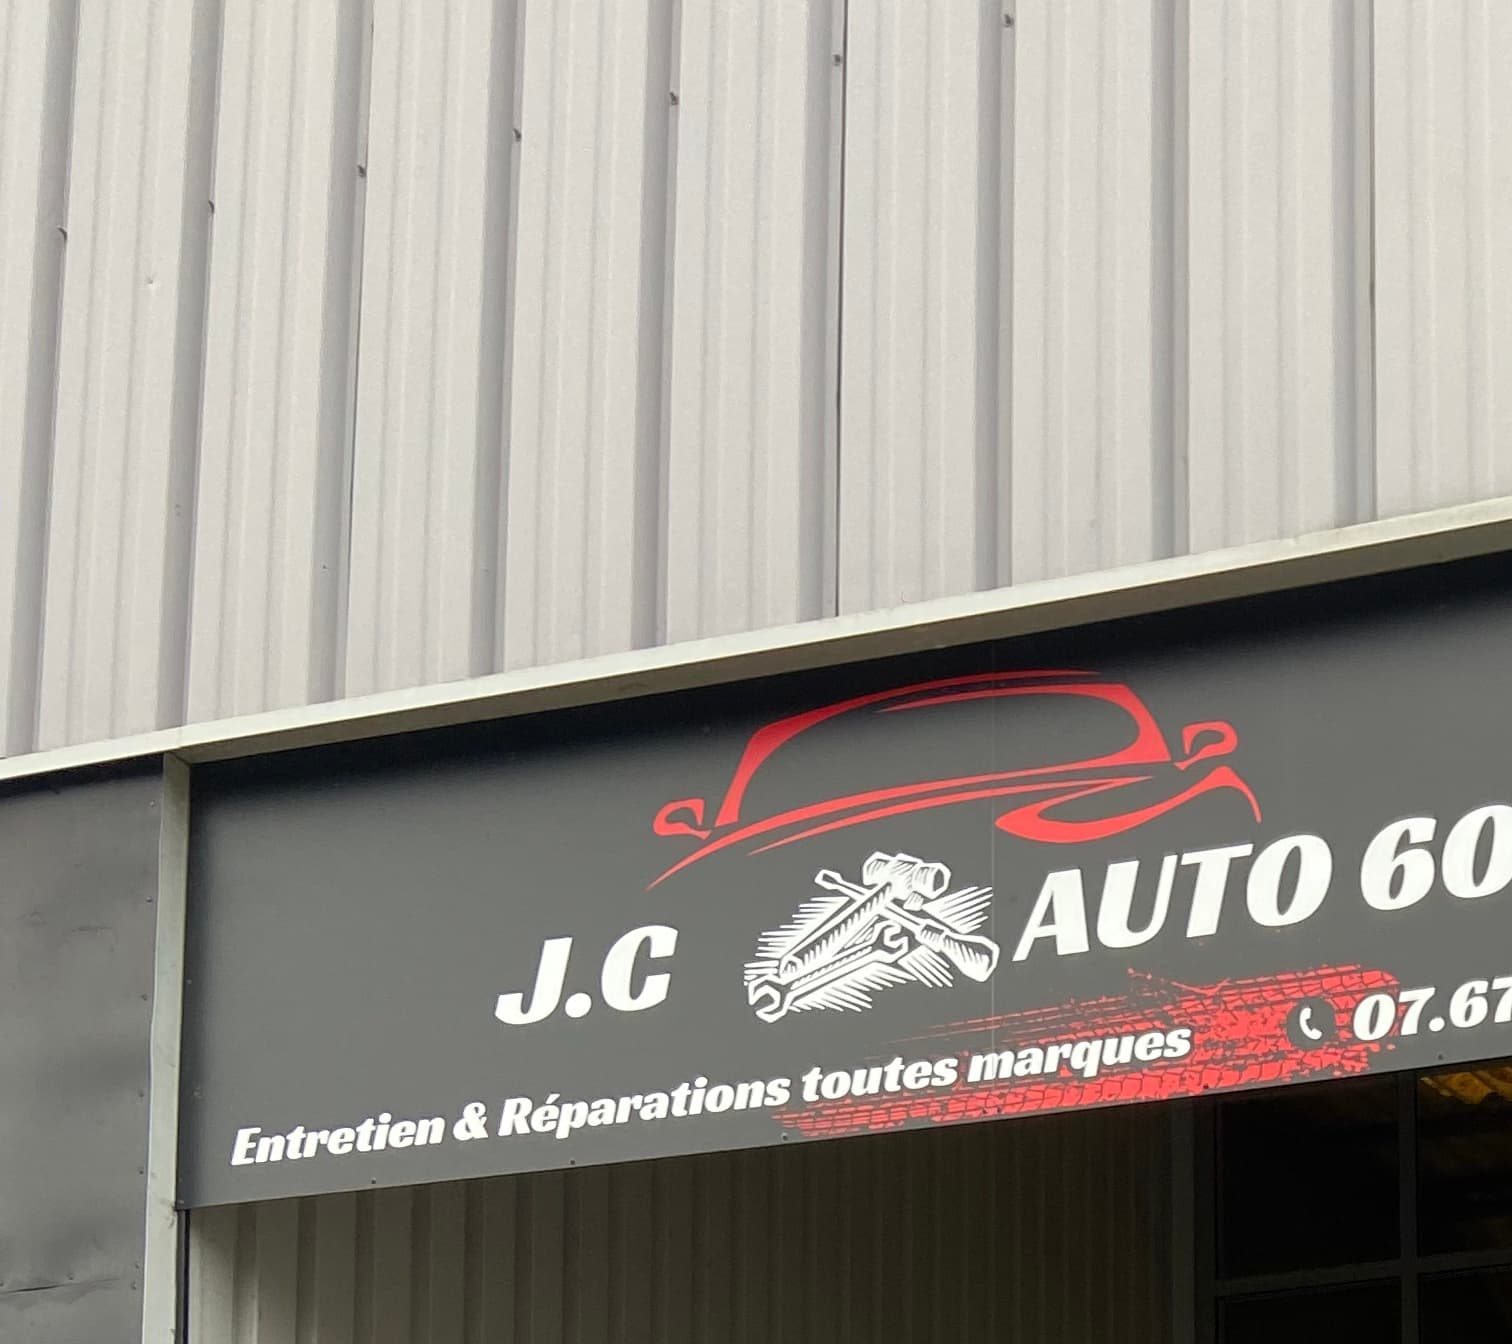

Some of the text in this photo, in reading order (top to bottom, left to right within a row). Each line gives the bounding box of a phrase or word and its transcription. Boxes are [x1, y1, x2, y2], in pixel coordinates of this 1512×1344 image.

[495, 923, 679, 1026] J.C
[1010, 833, 1334, 963] AUTO
[230, 1027, 1192, 1167] Entretien & Réparations toutes marques
